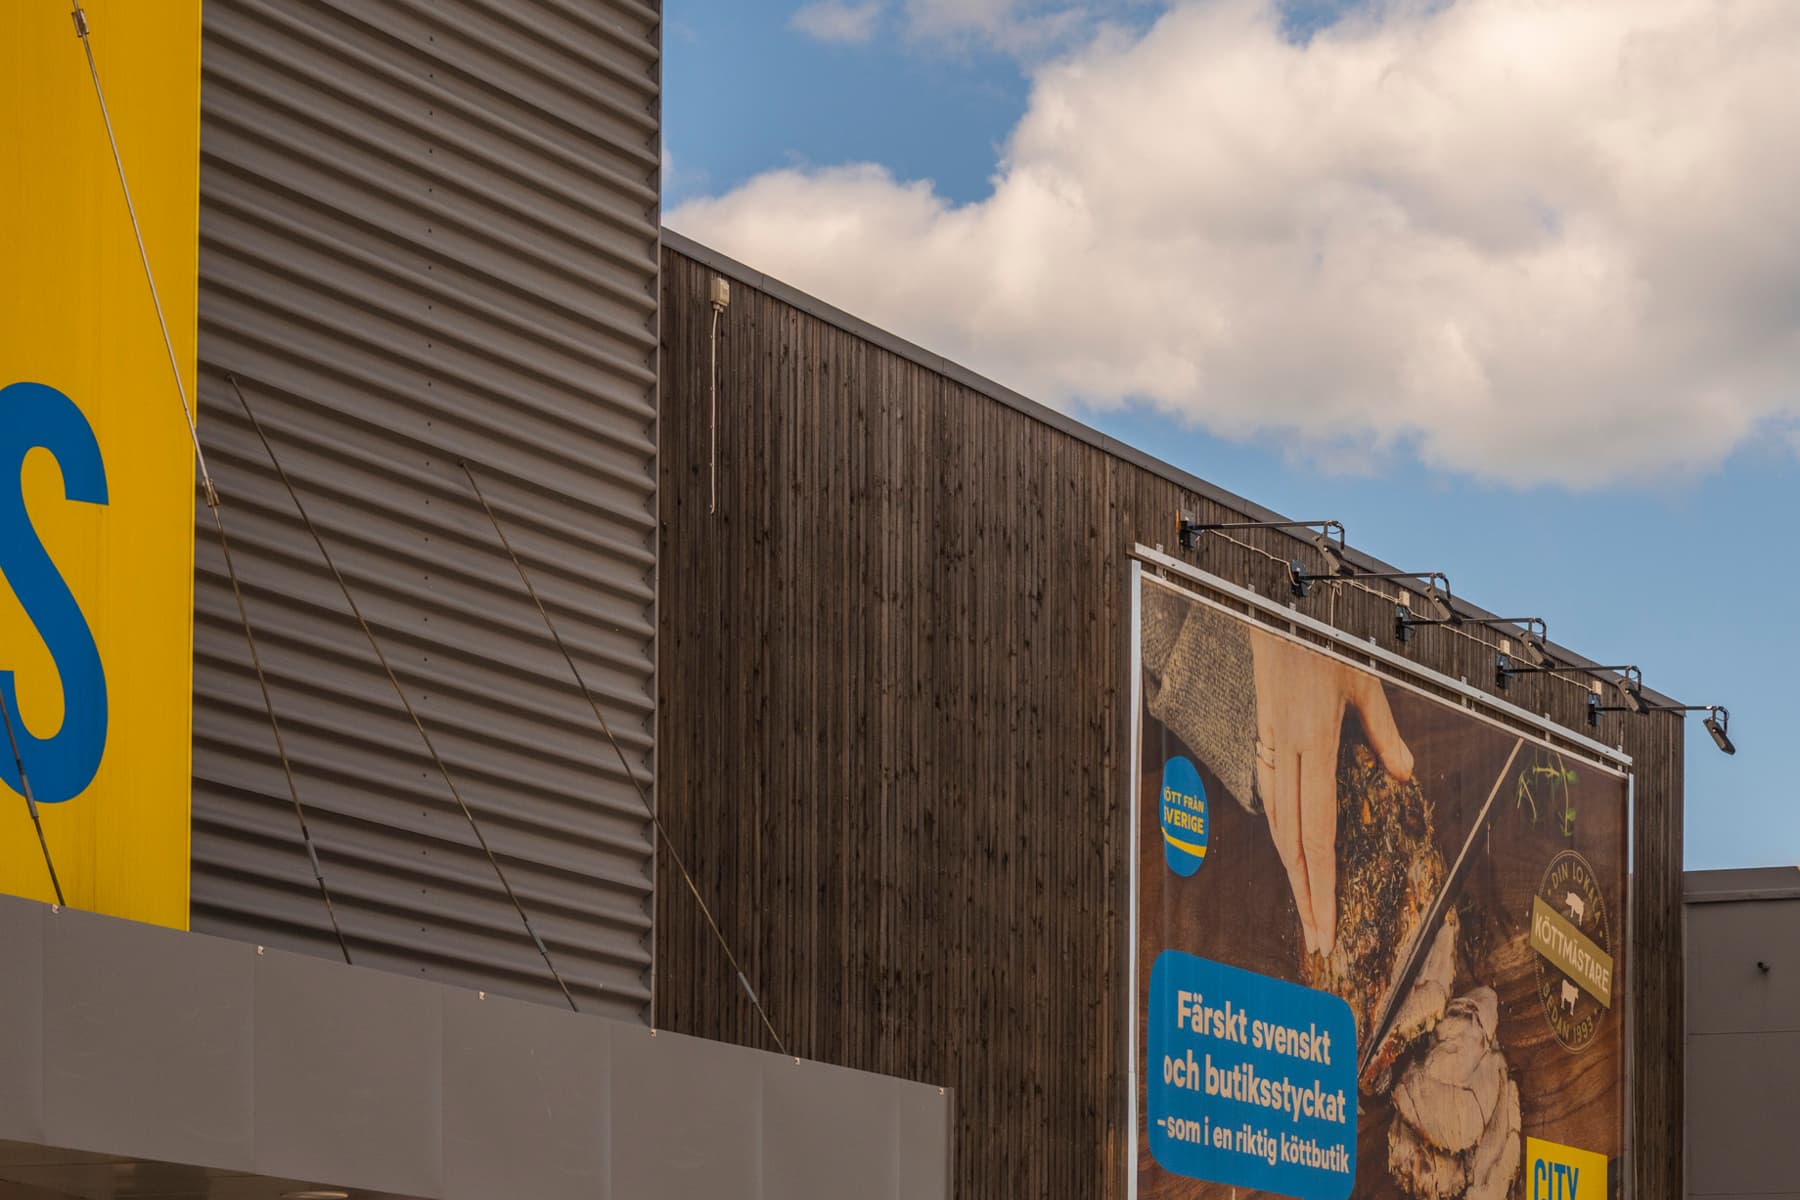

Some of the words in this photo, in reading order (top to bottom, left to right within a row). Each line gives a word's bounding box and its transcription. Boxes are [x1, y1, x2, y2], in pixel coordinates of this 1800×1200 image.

[1163, 786, 1182, 805] ÖTT
[1183, 794, 1205, 813] FRÅN
[1551, 863, 1570, 889] DIN
[1534, 911, 1609, 994] KÖTTMÄSTARE
[1177, 989, 1248, 1045] Färskt
[1252, 1013, 1331, 1065] svenskt
[1573, 1015, 1594, 1044] 1993
[1163, 1049, 1200, 1092] och
[1205, 1053, 1346, 1124] butiksstyckat
[1204, 1115, 1209, 1146] i
[1212, 1126, 1232, 1151] en
[1235, 1124, 1277, 1166] riktig
[1280, 1132, 1350, 1174] köttbutik
